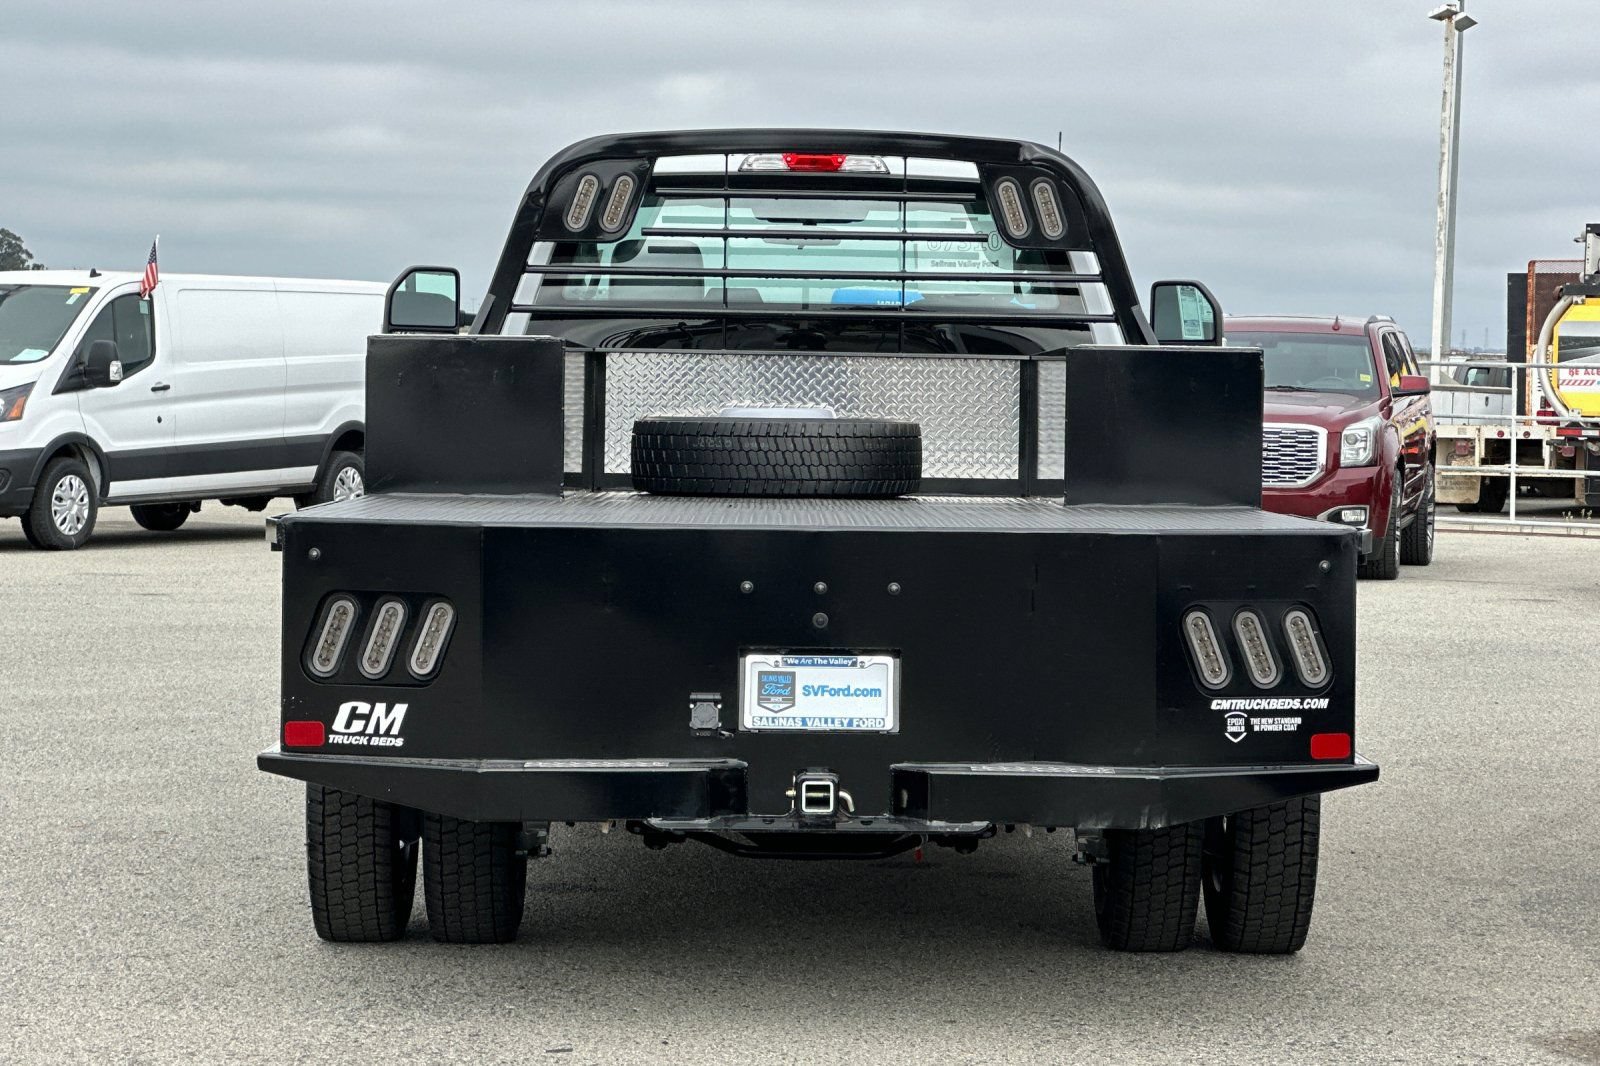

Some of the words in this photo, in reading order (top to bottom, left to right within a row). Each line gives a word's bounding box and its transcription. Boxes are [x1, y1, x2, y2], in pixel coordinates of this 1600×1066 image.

[761, 683, 791, 696] Ford
[802, 685, 882, 697] SVFord.com
[1210, 698, 1330, 710] CMTRUCKBEDS.COM
[332, 701, 408, 735] CM
[753, 717, 803, 727] SALINAS
[806, 717, 850, 727] VALLEY
[853, 718, 884, 728] FORD
[1227, 718, 1245, 726] EPOXI
[328, 734, 368, 745] TRUCK
[370, 736, 404, 747] BEDS
